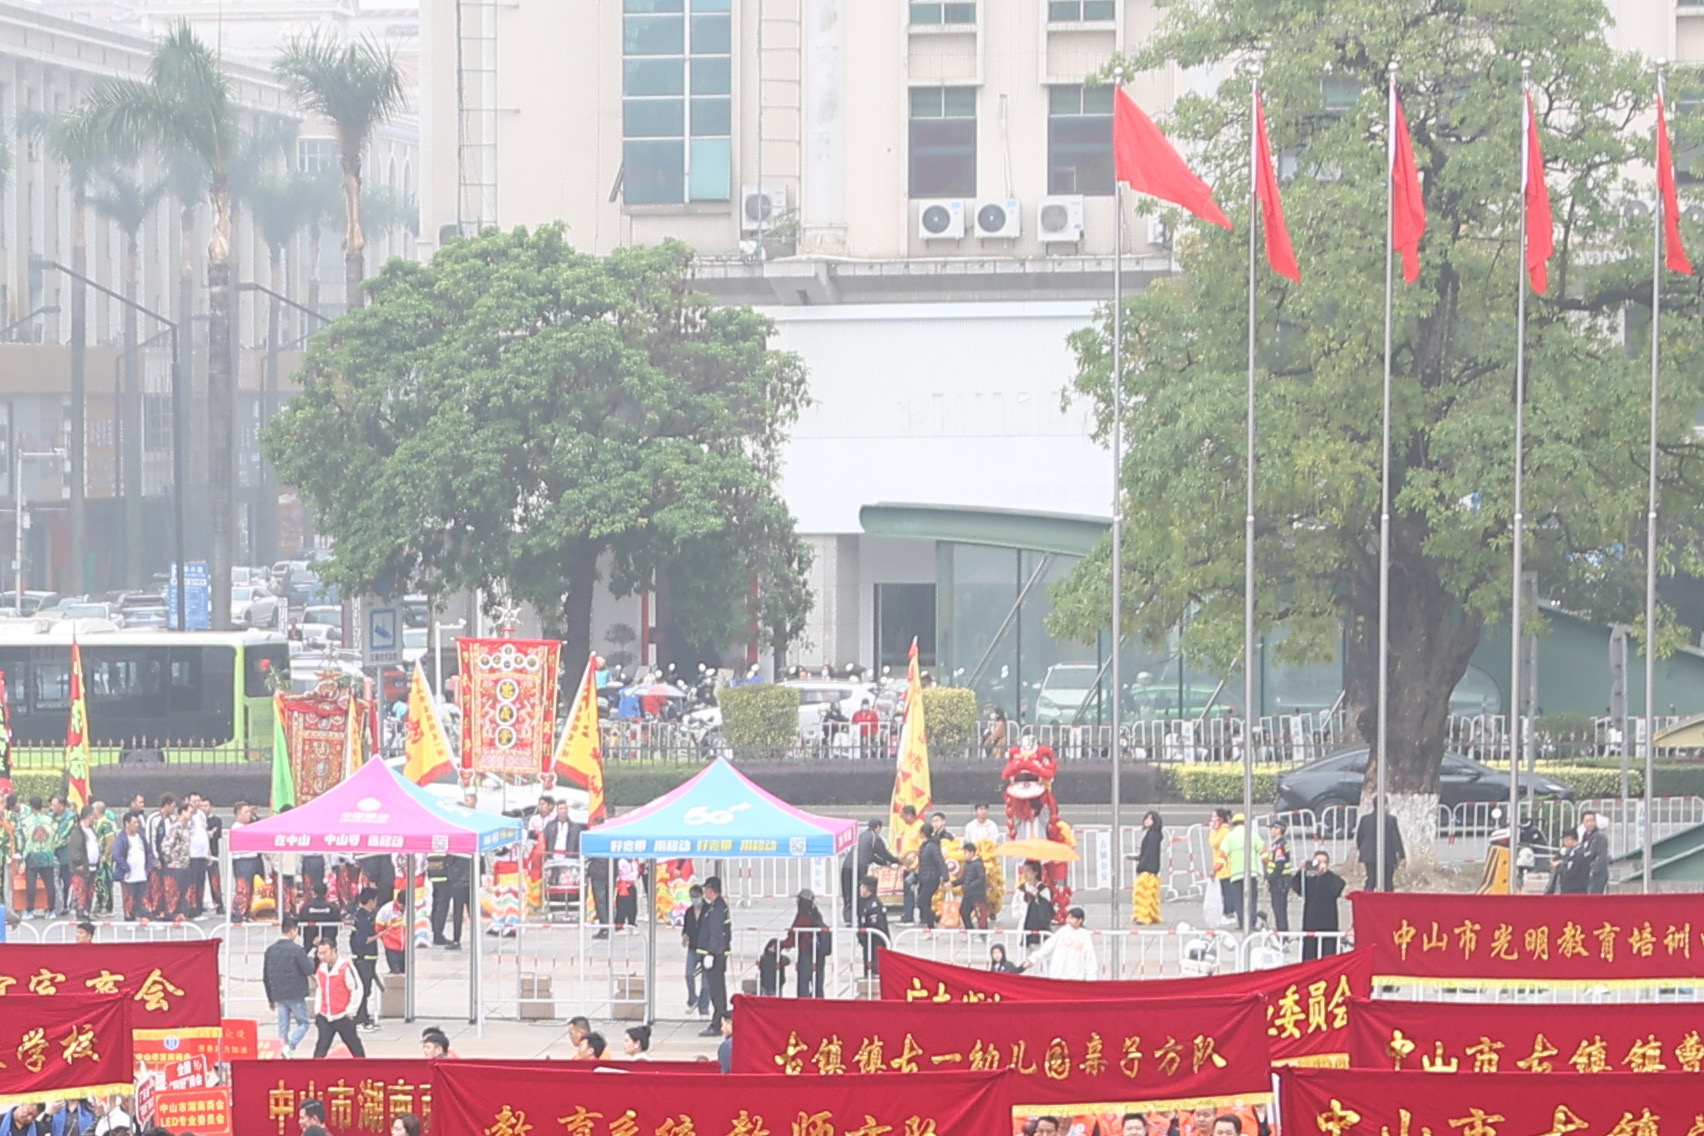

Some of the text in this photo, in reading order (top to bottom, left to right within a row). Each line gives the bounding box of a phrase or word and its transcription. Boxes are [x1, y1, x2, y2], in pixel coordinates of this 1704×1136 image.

[1393, 919, 1704, 962] 中山市光明教育培训
[1266, 974, 1352, 1039] 委员会
[159, 1099, 225, 1114] 中山市湖南商会
[160, 1115, 225, 1128] LED专业委员会
